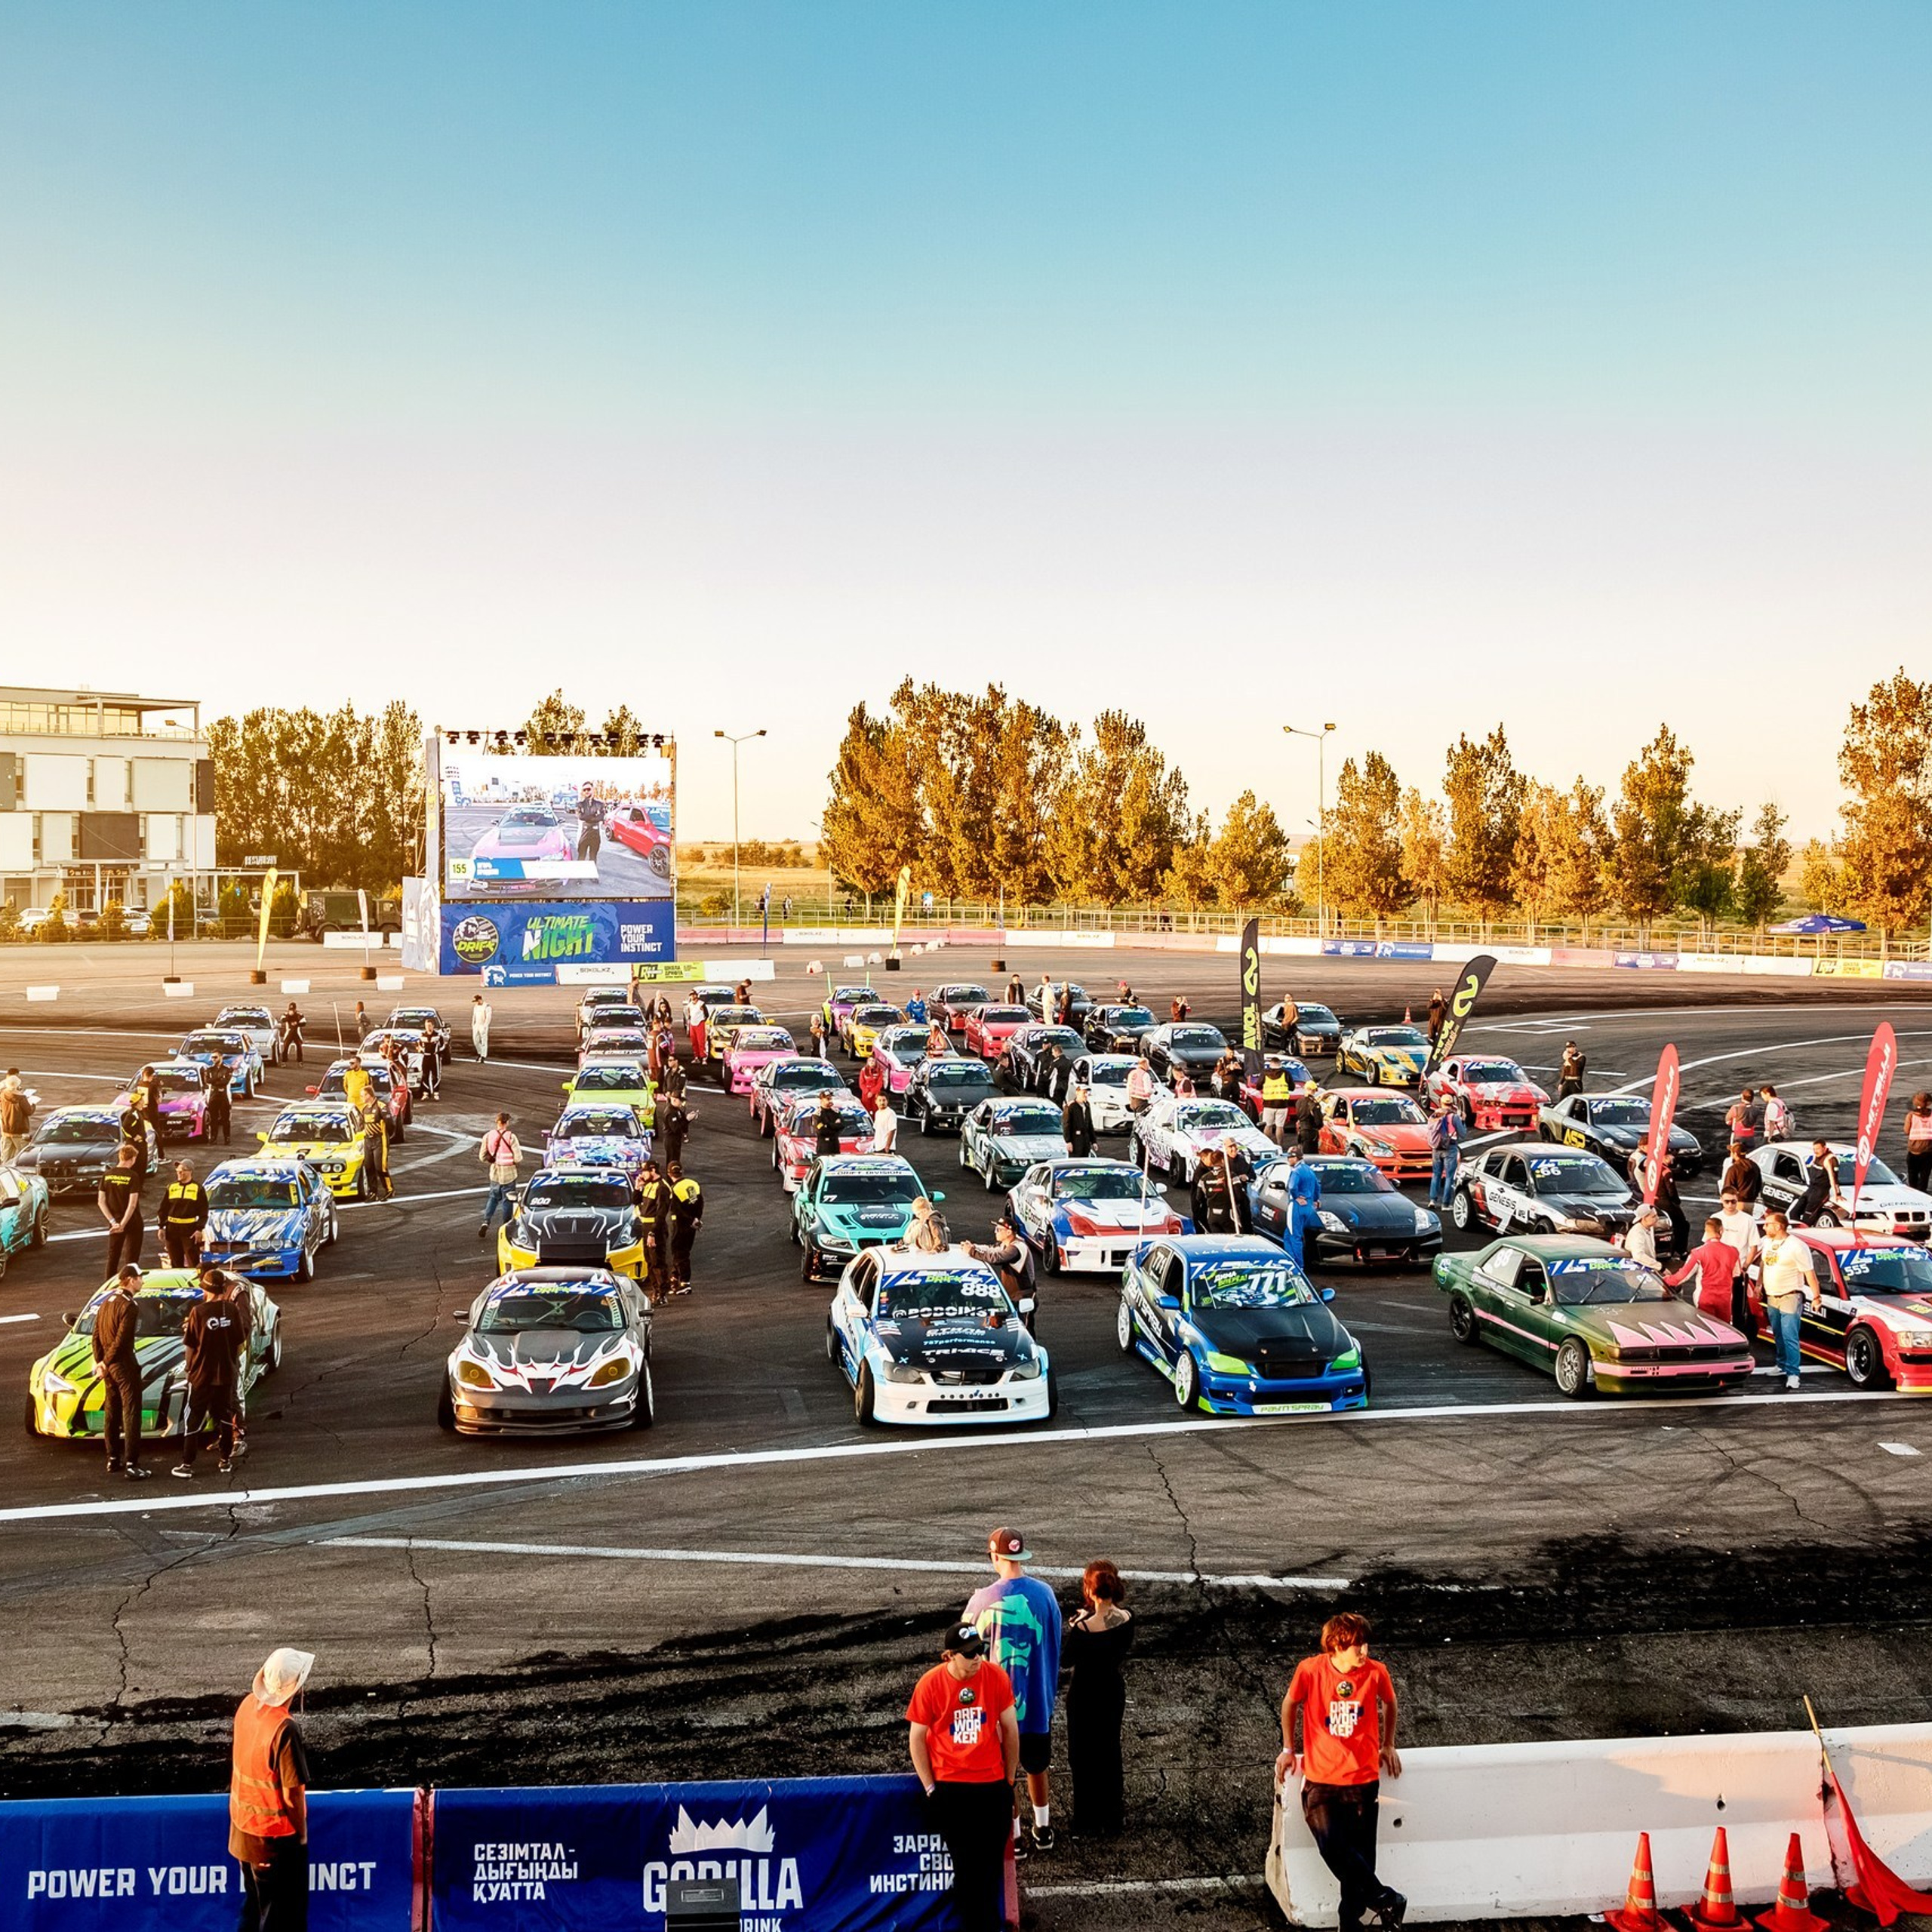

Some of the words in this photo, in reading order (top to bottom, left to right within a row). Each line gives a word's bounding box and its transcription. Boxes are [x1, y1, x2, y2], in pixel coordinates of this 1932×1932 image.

[452, 863, 466, 874] 155
[526, 915, 590, 931] ULTIMATE
[620, 924, 654, 934] POWER
[522, 923, 596, 961] NIGHT
[620, 933, 646, 943] YOUR
[620, 942, 663, 953] INSTINCT
[1540, 1167, 1561, 1176] 66
[530, 1197, 552, 1206] 900
[822, 1195, 838, 1203] 77
[1488, 1192, 1517, 1211] GENESIS
[1762, 1186, 1795, 1204] GENESIS
[1844, 1263, 1870, 1277] 555
[960, 1282, 1002, 1299] 888
[1248, 1271, 1286, 1297] 771
[954, 1718, 981, 1732] WOR
[1330, 1712, 1358, 1726] WOR
[953, 1731, 977, 1744] KER
[1329, 1724, 1354, 1738] KER
[893, 1834, 949, 1854] ЗАРЯ
[919, 1853, 955, 1872] СВО
[27, 1868, 136, 1900] POWER
[147, 1866, 227, 1895] YOUR
[239, 1861, 377, 1893] IINCT
[869, 1872, 955, 1894] ИНСТИНК
[473, 1881, 546, 1903] ҚУАТТА
